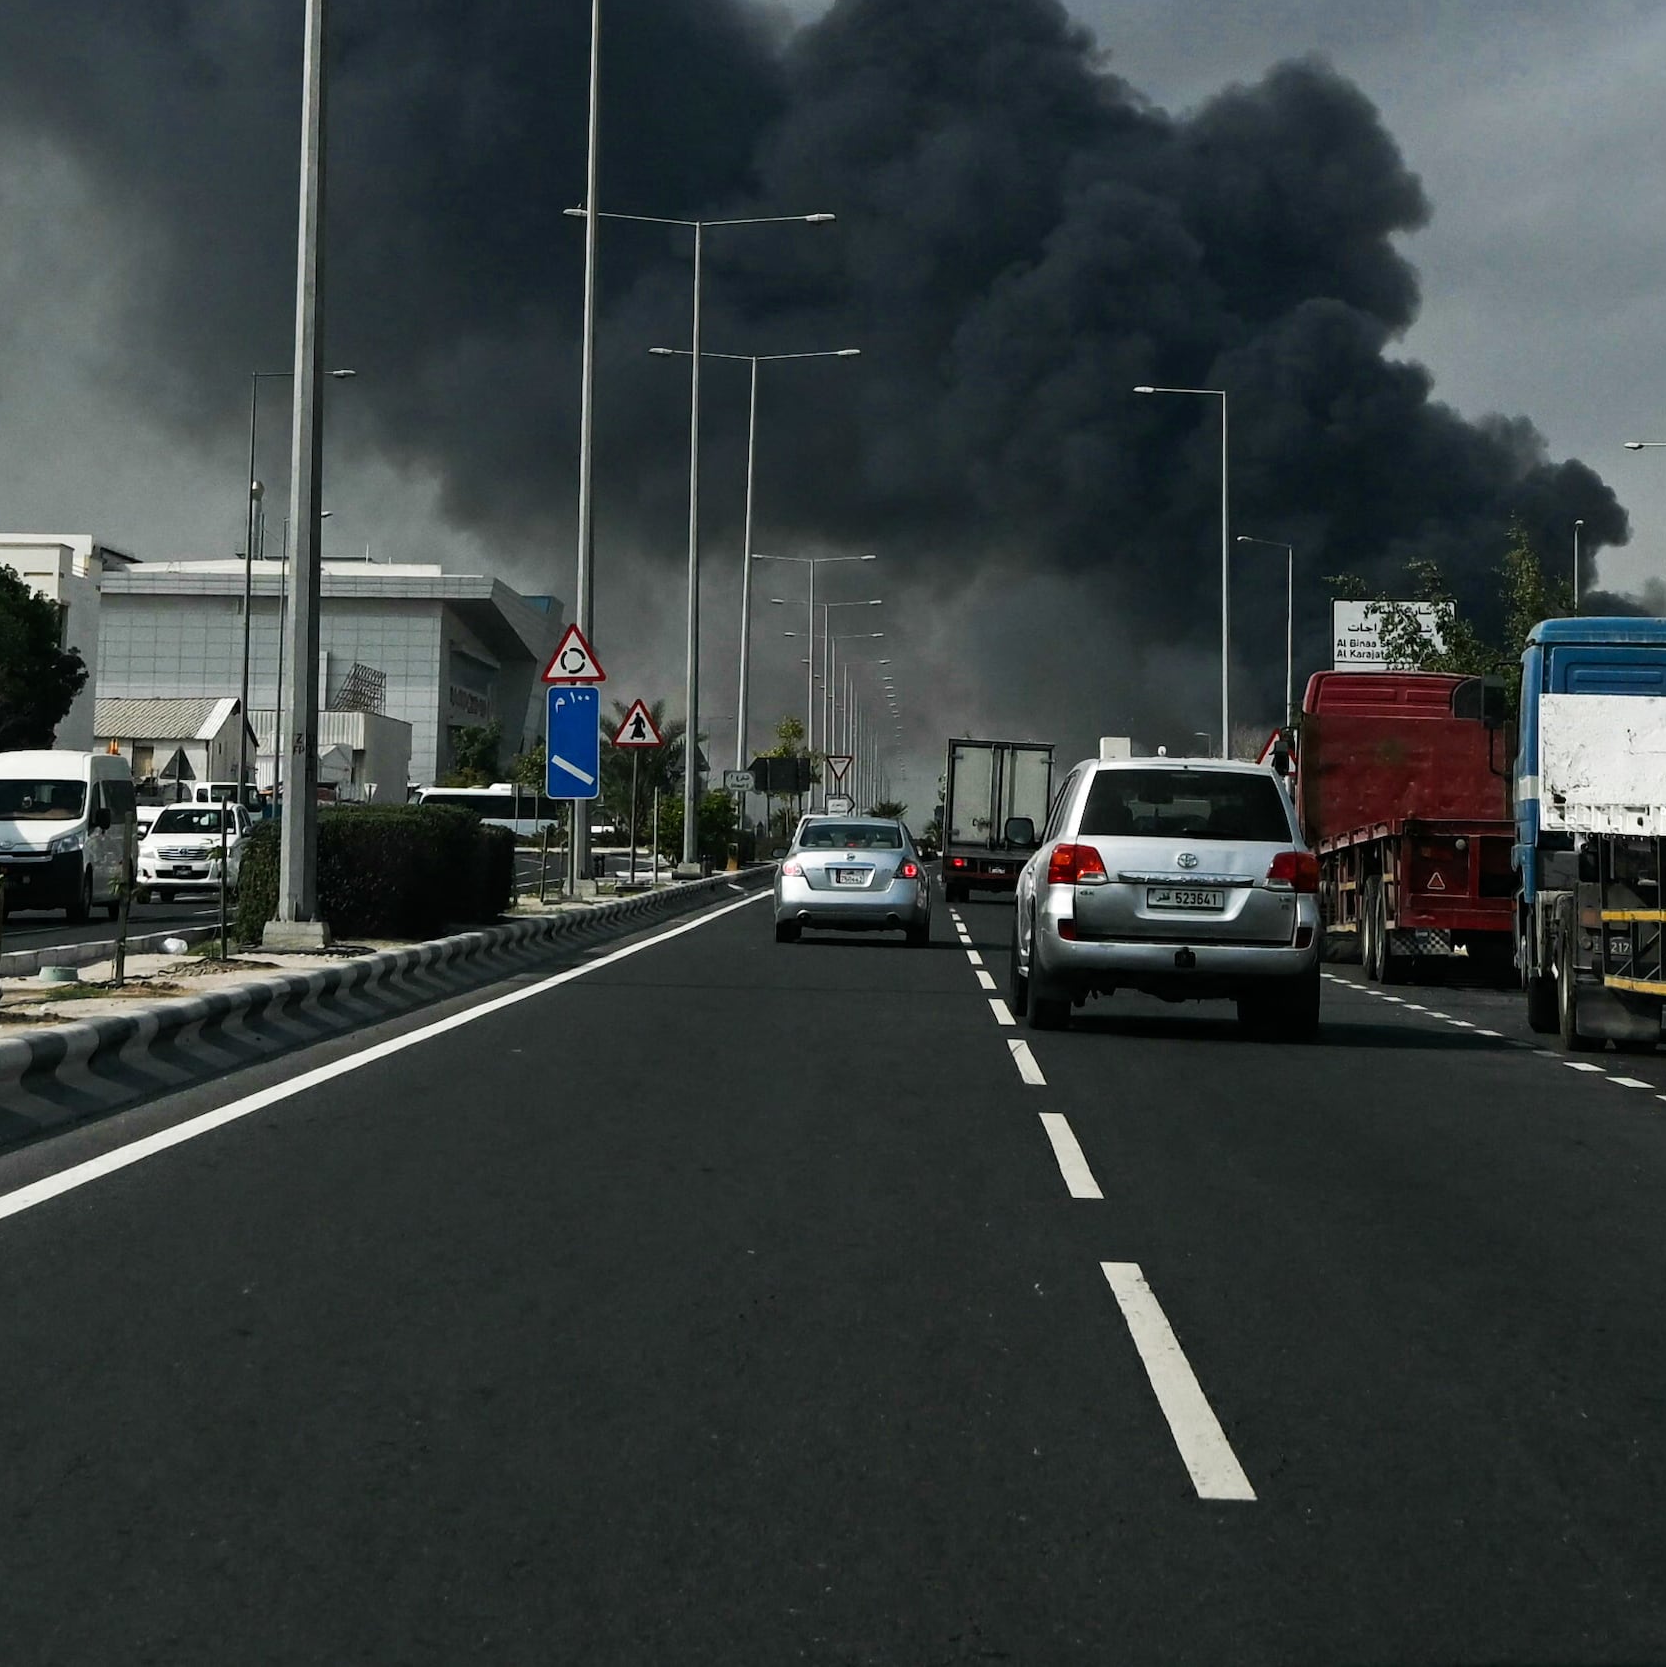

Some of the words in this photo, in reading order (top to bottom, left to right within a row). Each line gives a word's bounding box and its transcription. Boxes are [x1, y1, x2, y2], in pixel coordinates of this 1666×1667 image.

[1337, 639, 1346, 647] Al
[1350, 639, 1377, 648] Binaa
[1337, 649, 1346, 658] Al
[1350, 649, 1386, 659] Karajat
[569, 691, 590, 704] ١٠٠
[555, 697, 566, 714] م
[1175, 892, 1217, 906] 523641
